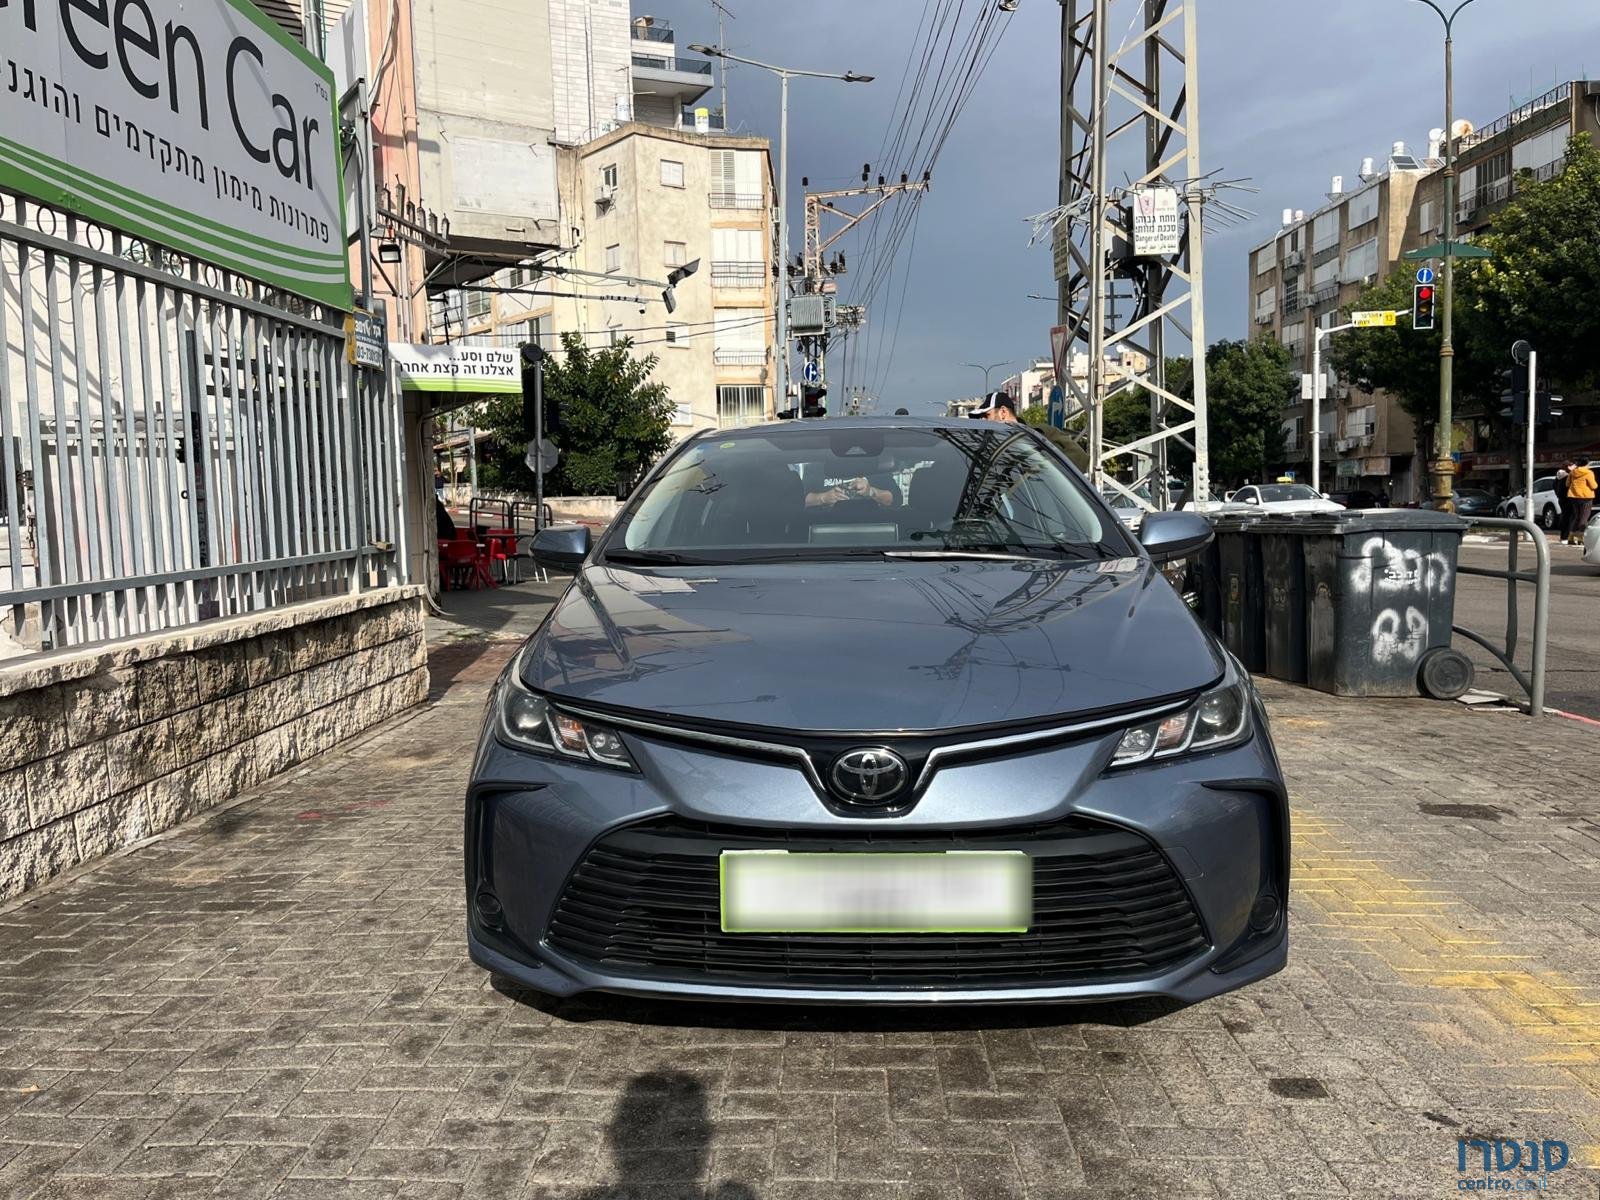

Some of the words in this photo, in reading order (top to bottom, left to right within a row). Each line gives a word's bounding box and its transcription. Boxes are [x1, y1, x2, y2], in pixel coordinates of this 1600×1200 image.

[0, 58, 81, 124] והוגנ
[0, 0, 209, 130] een
[226, 36, 319, 190] Car
[94, 104, 205, 184] מתקדמים
[213, 166, 263, 212] מימון
[269, 195, 329, 244] פתרונות
[1135, 234, 1154, 243] Danger
[448, 351, 482, 362] וסע...
[486, 351, 514, 363] שלם
[433, 363, 459, 377] קצת
[463, 364, 477, 375] זה
[480, 363, 514, 376] אצלנו
